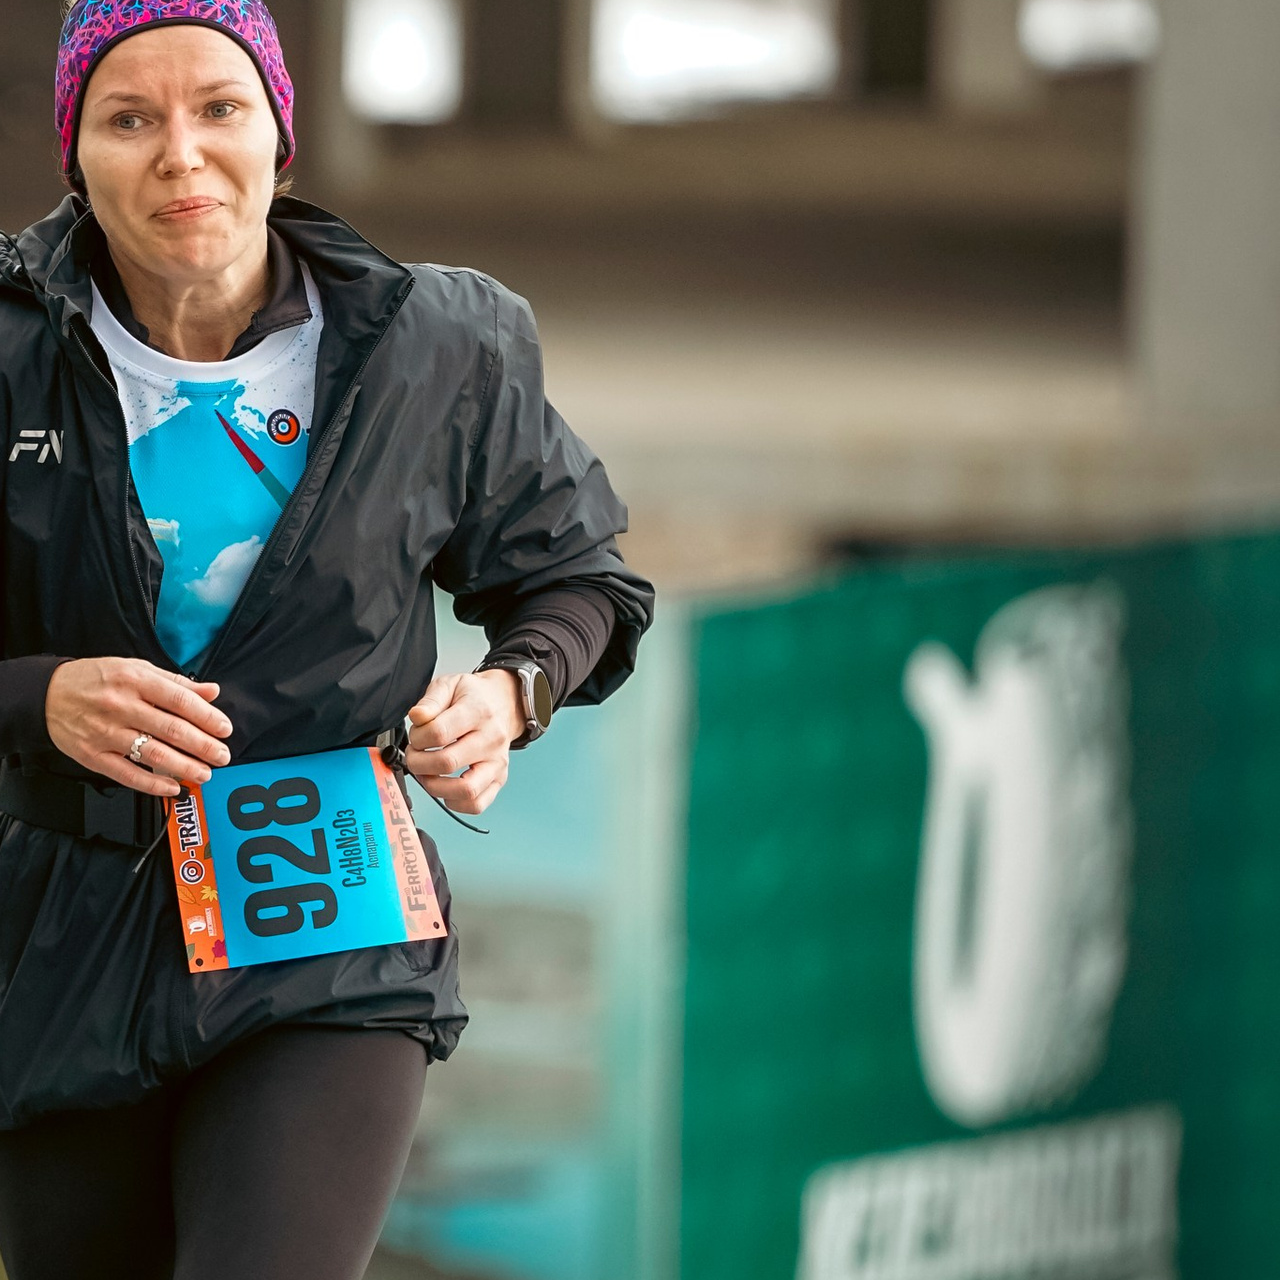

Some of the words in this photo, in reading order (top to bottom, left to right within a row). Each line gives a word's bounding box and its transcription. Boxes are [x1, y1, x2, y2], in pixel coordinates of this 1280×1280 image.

[227, 777, 339, 938] 928
[332, 808, 367, 888] C4H8N2O3
[363, 822, 380, 869] Аспарагин
